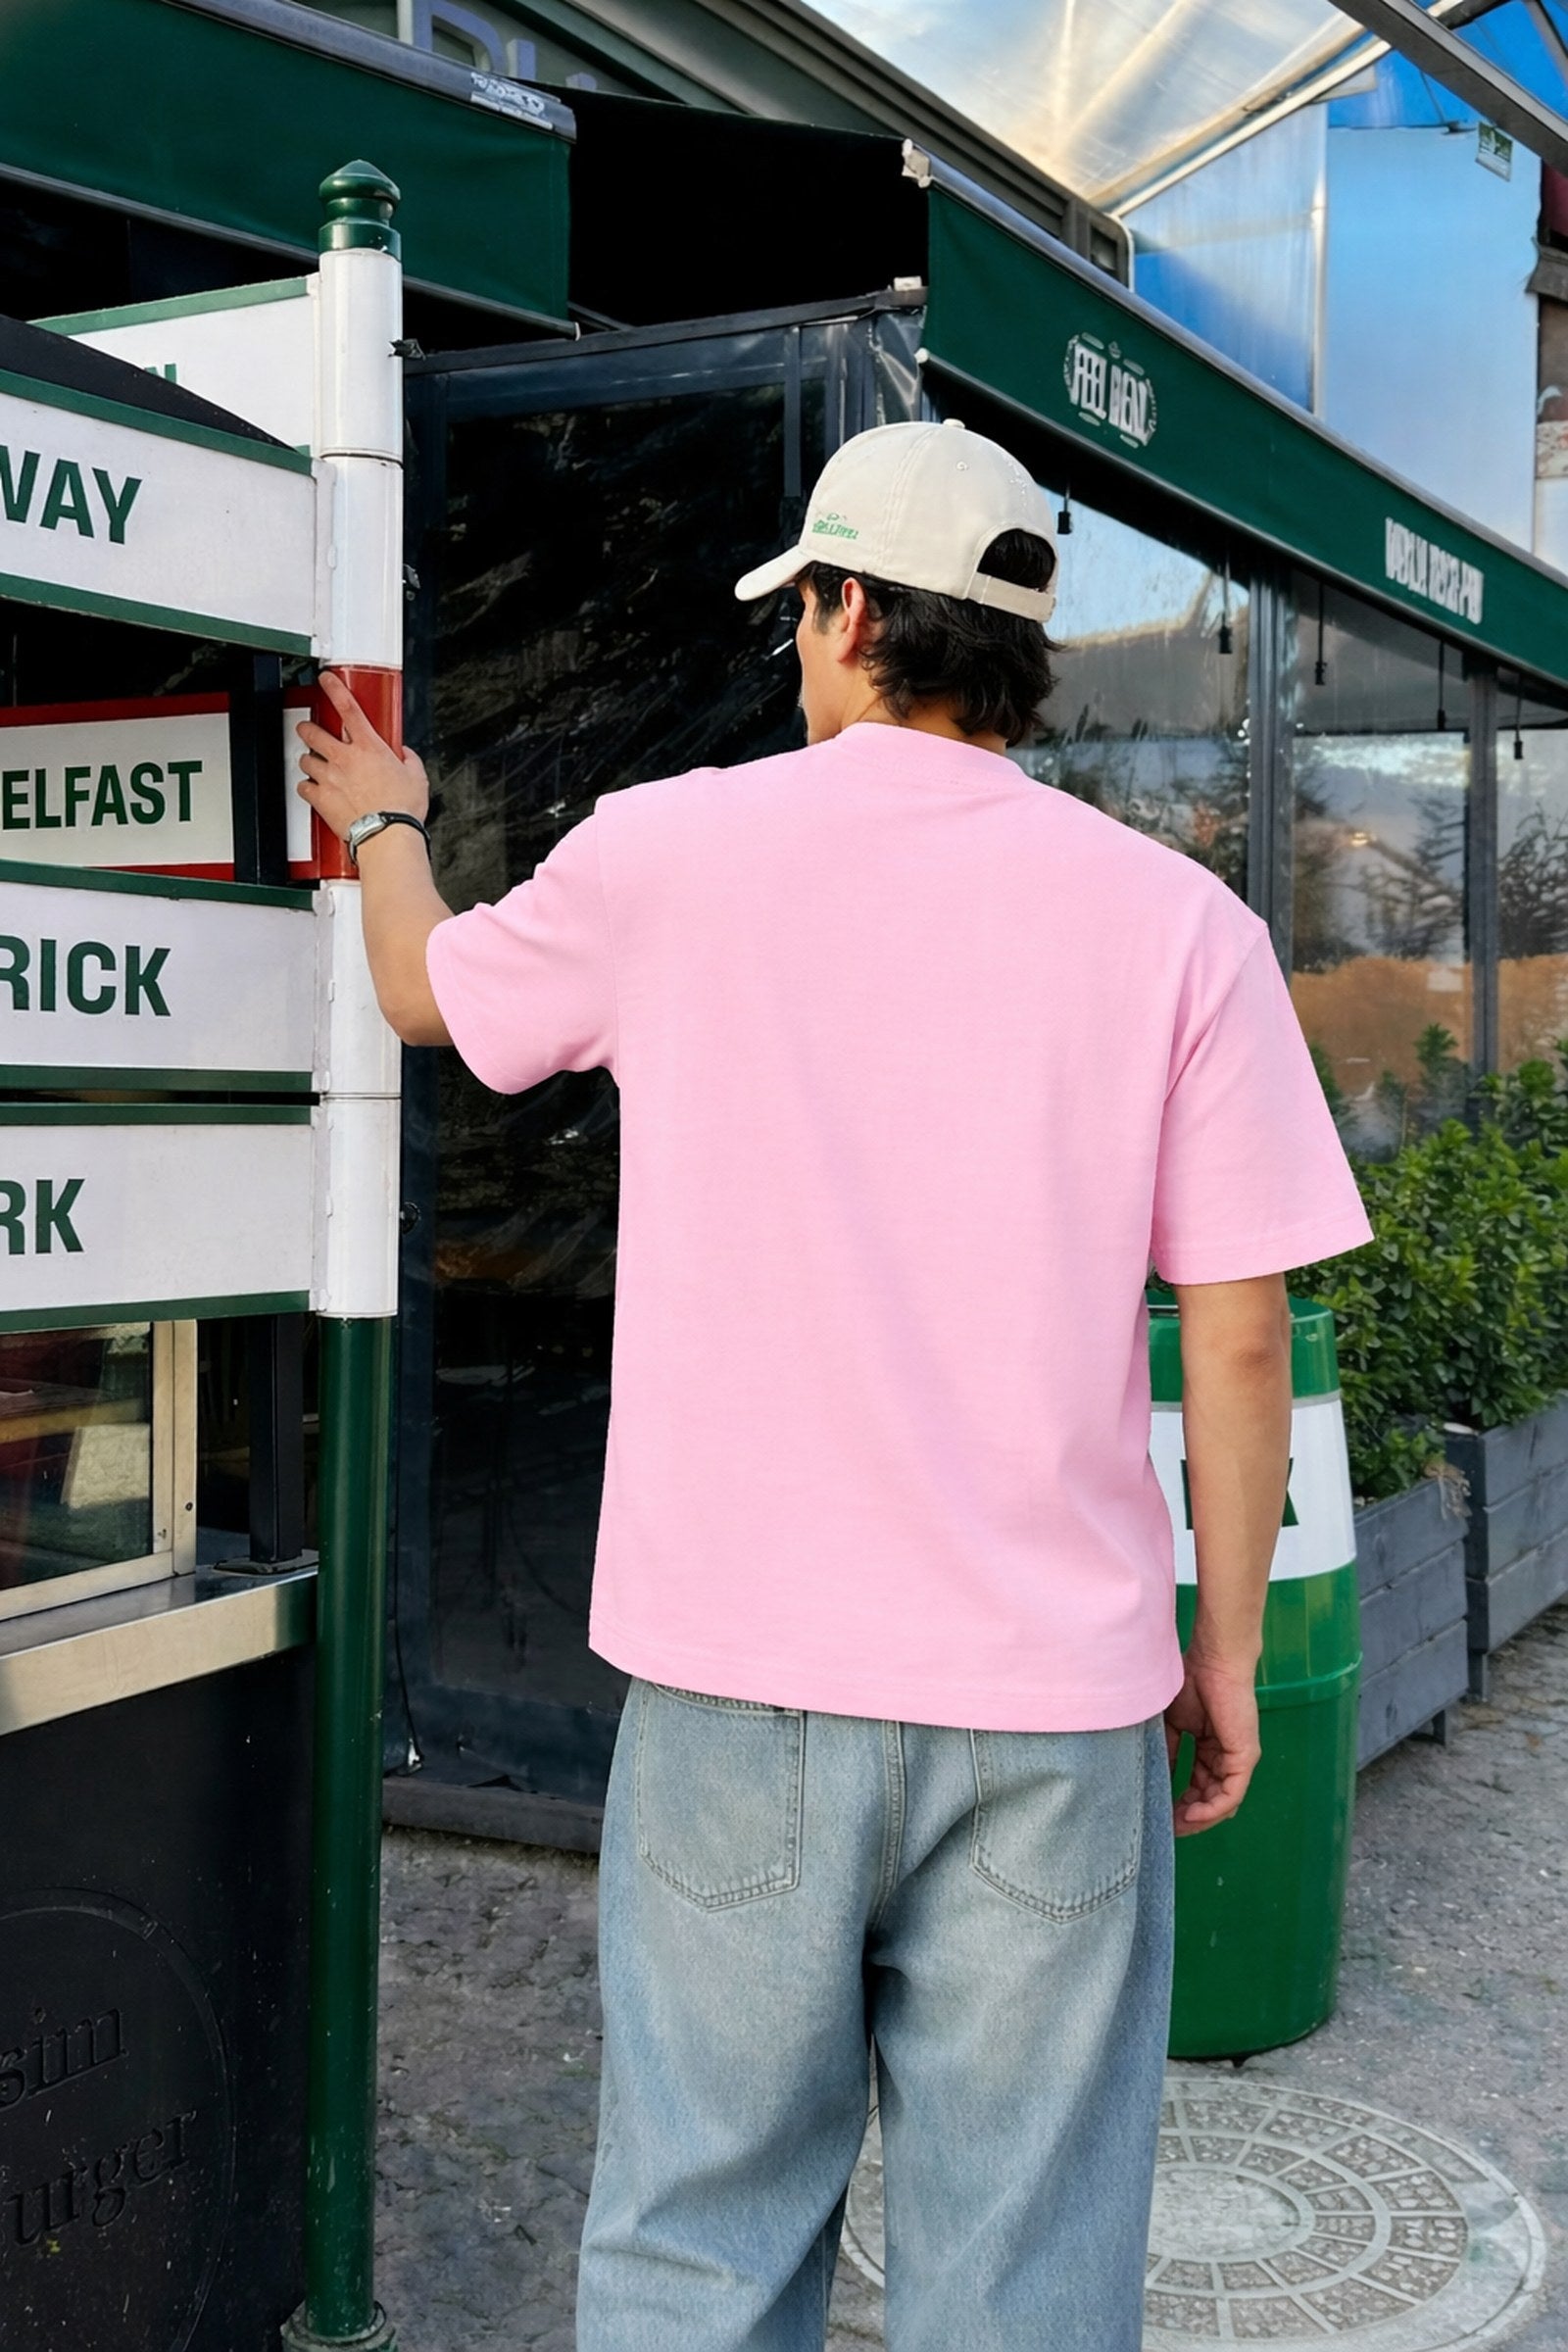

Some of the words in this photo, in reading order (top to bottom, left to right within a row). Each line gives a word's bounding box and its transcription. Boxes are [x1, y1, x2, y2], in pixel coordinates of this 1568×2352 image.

[2, 760, 203, 830] ELFAST
[0, 934, 172, 1017] RICK
[0, 1178, 85, 1255] RK
